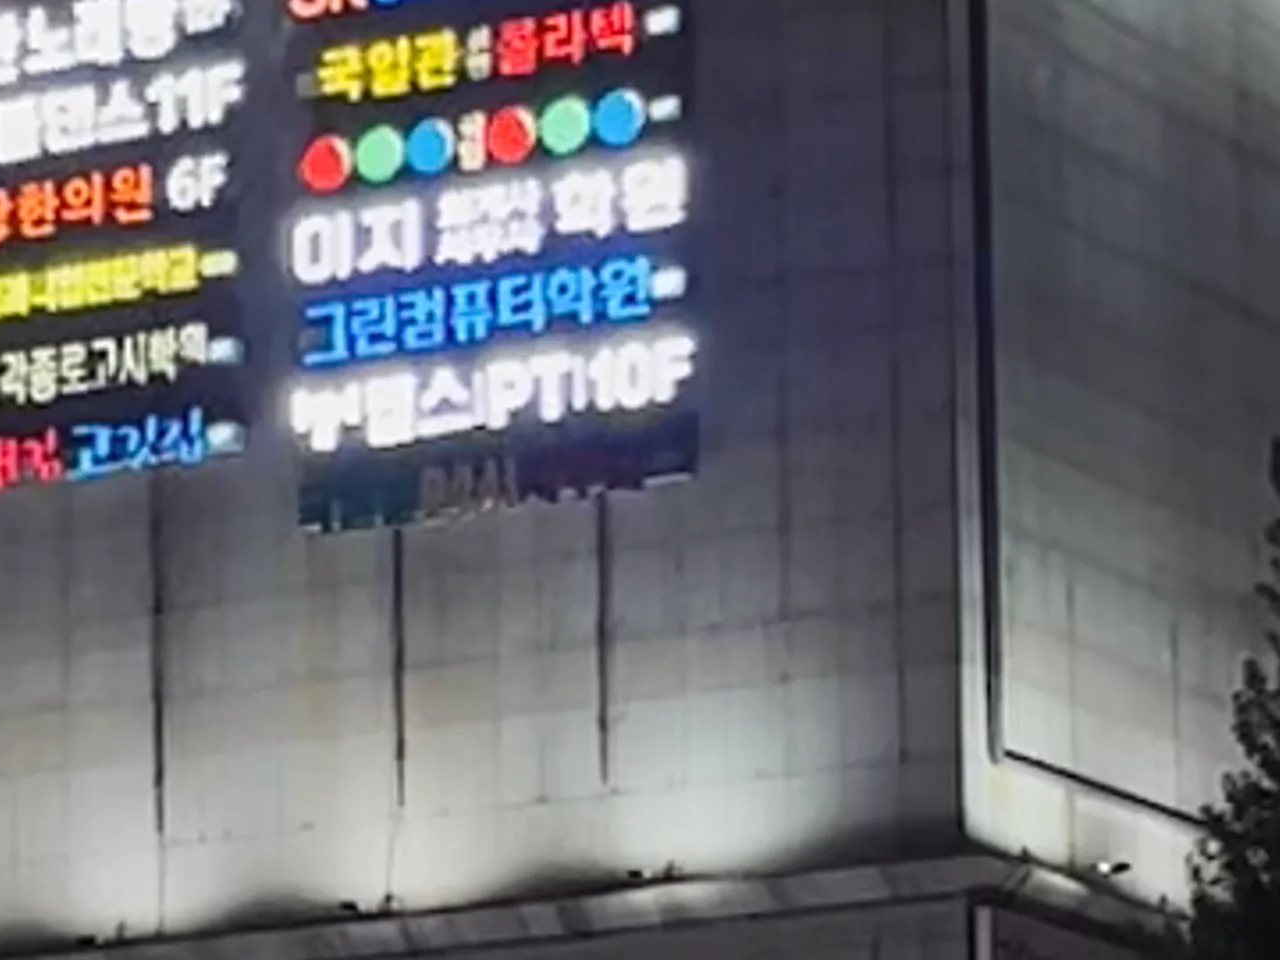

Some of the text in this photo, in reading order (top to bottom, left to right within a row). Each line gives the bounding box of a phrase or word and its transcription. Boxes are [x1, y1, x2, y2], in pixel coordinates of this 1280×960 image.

[145, 61, 245, 135] 11F
[317, 27, 462, 101] 국일관
[166, 153, 229, 211] 6F
[293, 196, 419, 284] 이지
[302, 254, 652, 366] 그린컴퓨터학원
